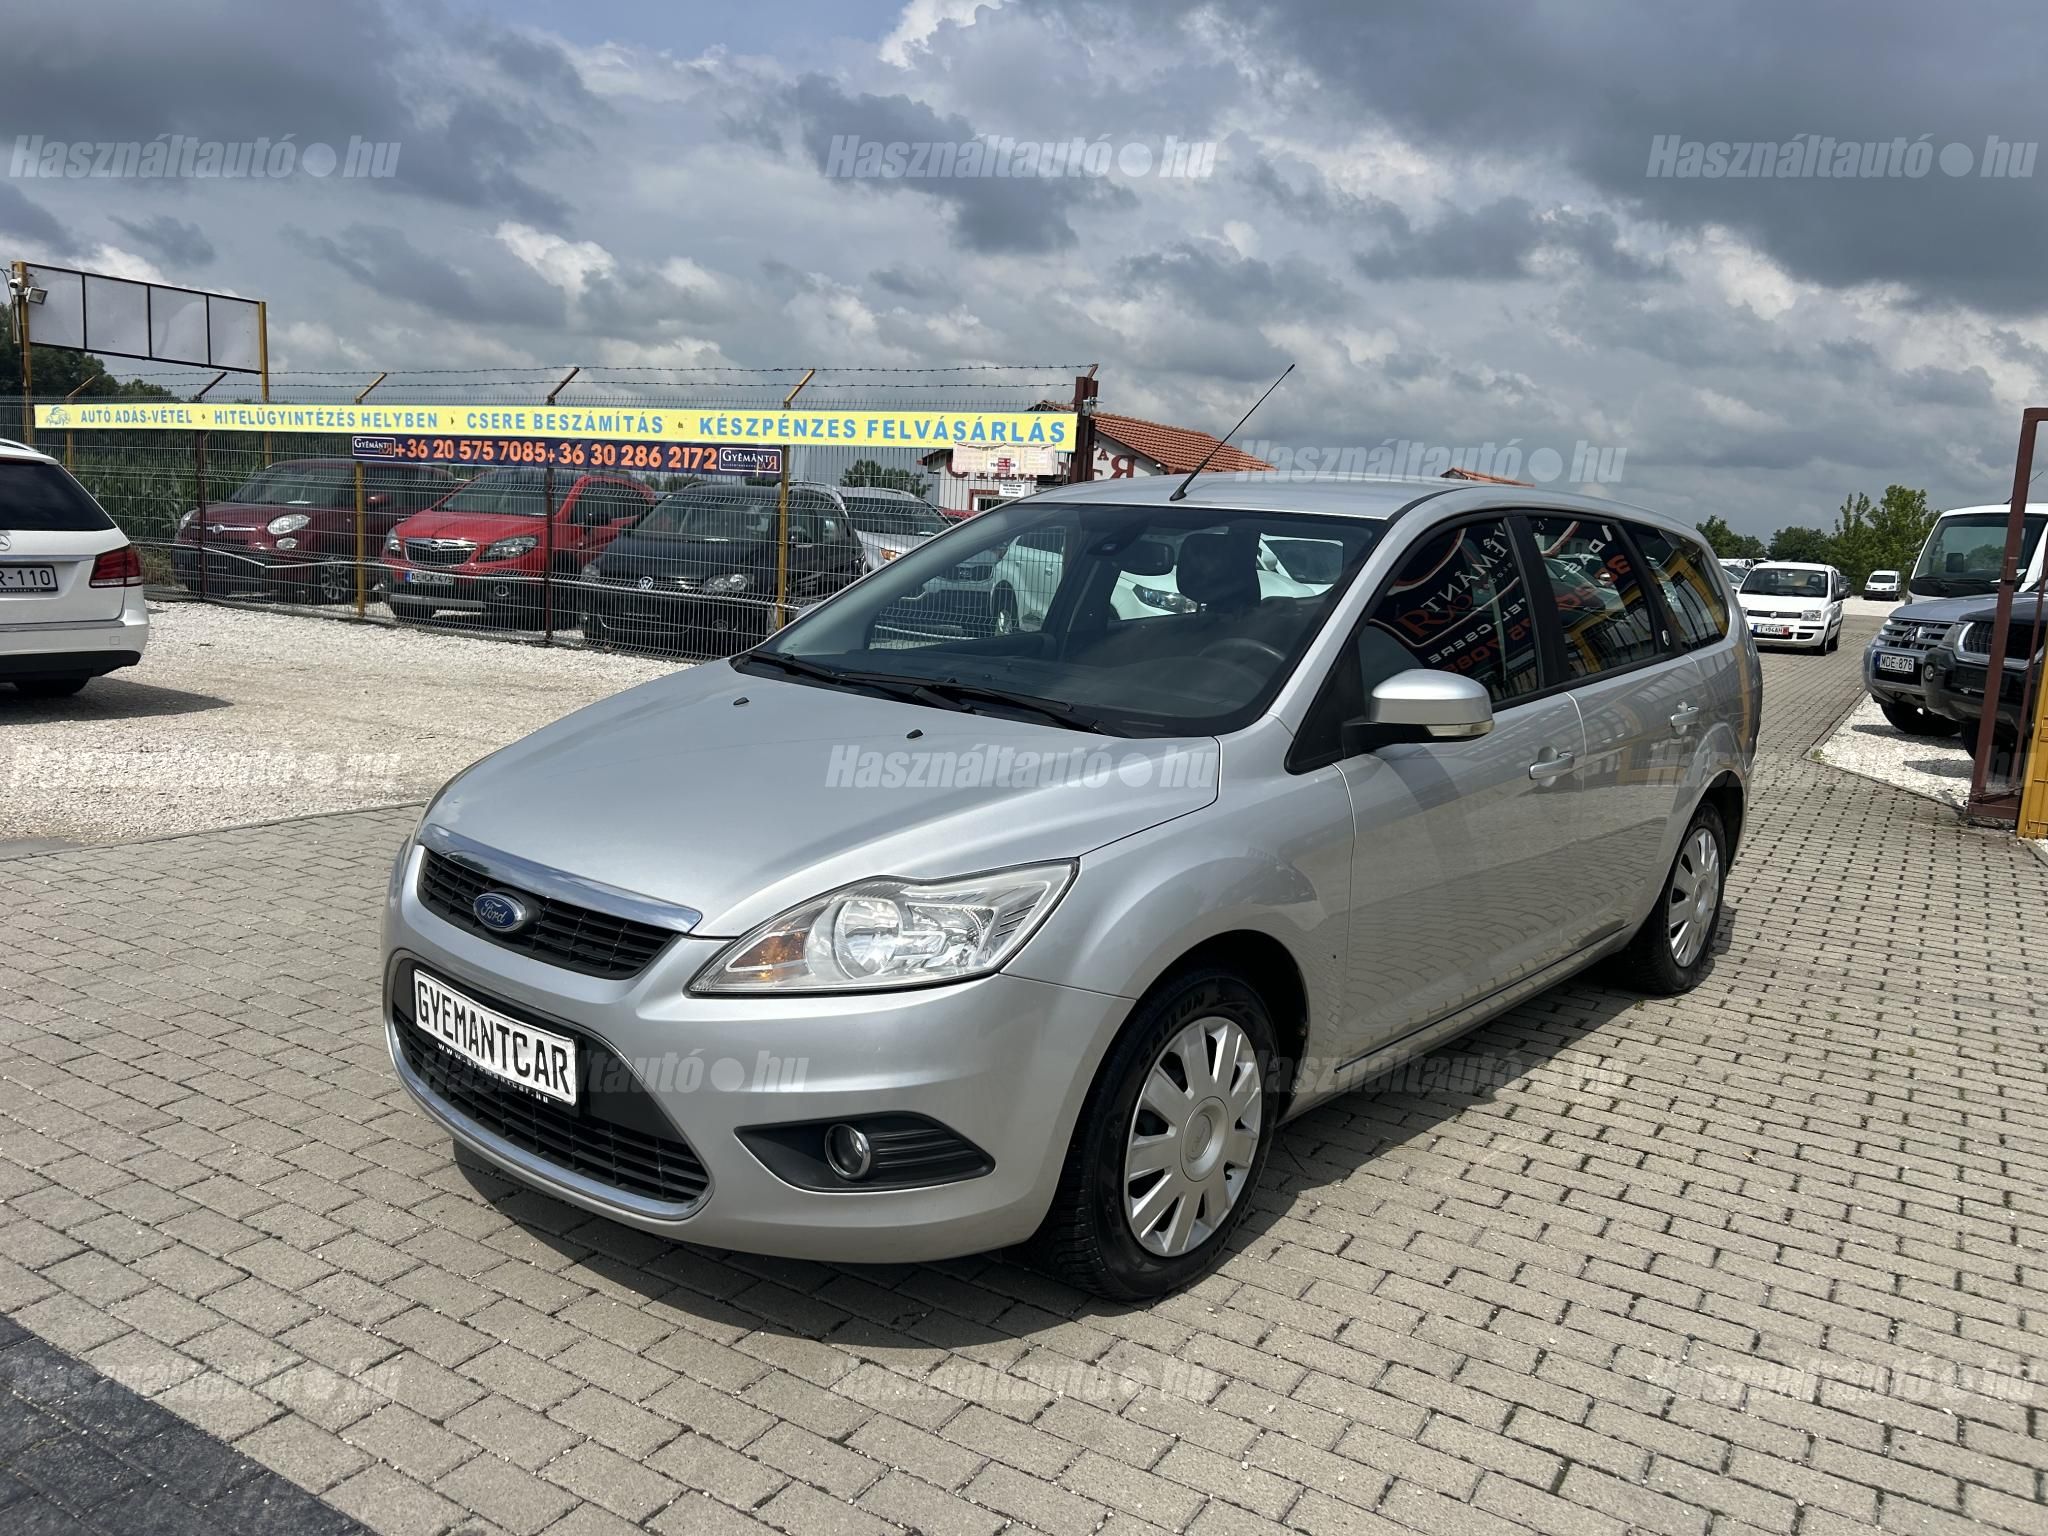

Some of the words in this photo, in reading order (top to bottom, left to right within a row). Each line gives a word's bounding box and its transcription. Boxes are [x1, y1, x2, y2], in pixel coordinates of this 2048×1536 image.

[81, 406, 111, 423] AUTÓ
[115, 406, 192, 424] ADÁS-VÉTEL
[361, 412, 438, 428] HELYBEN
[467, 413, 526, 430] CSERE
[533, 411, 663, 434] BESZÁMÍTÁS
[699, 413, 856, 439] KÉSZPÉNZES
[867, 416, 1065, 443] FELVÁSÁRLÁS
[433, 440, 454, 459] 20
[459, 440, 494, 461] 575
[498, 441, 547, 463] 7085
[590, 443, 616, 466] 30
[620, 445, 662, 468] 286
[668, 446, 717, 470] 2172
[1881, 655, 1913, 671] MDE-876
[480, 899, 508, 923] Ford
[417, 980, 571, 1095] GYEMANTCAR
